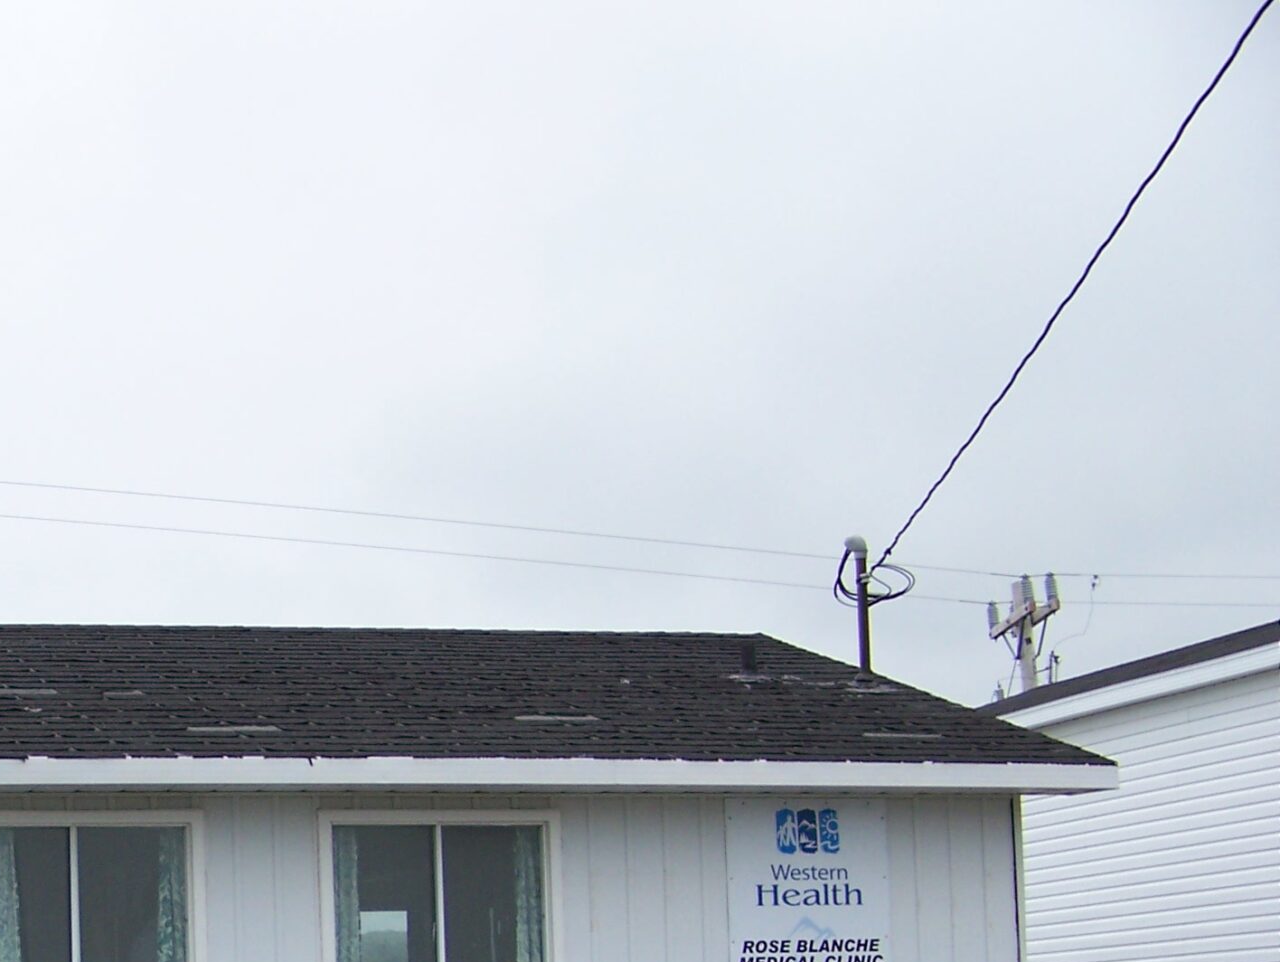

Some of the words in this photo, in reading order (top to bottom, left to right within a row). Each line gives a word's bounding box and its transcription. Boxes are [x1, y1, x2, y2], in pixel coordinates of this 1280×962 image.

[770, 864, 848, 881] Western
[756, 884, 864, 907] Health
[742, 940, 791, 954] ROSE
[796, 939, 880, 953] BLANCHE
